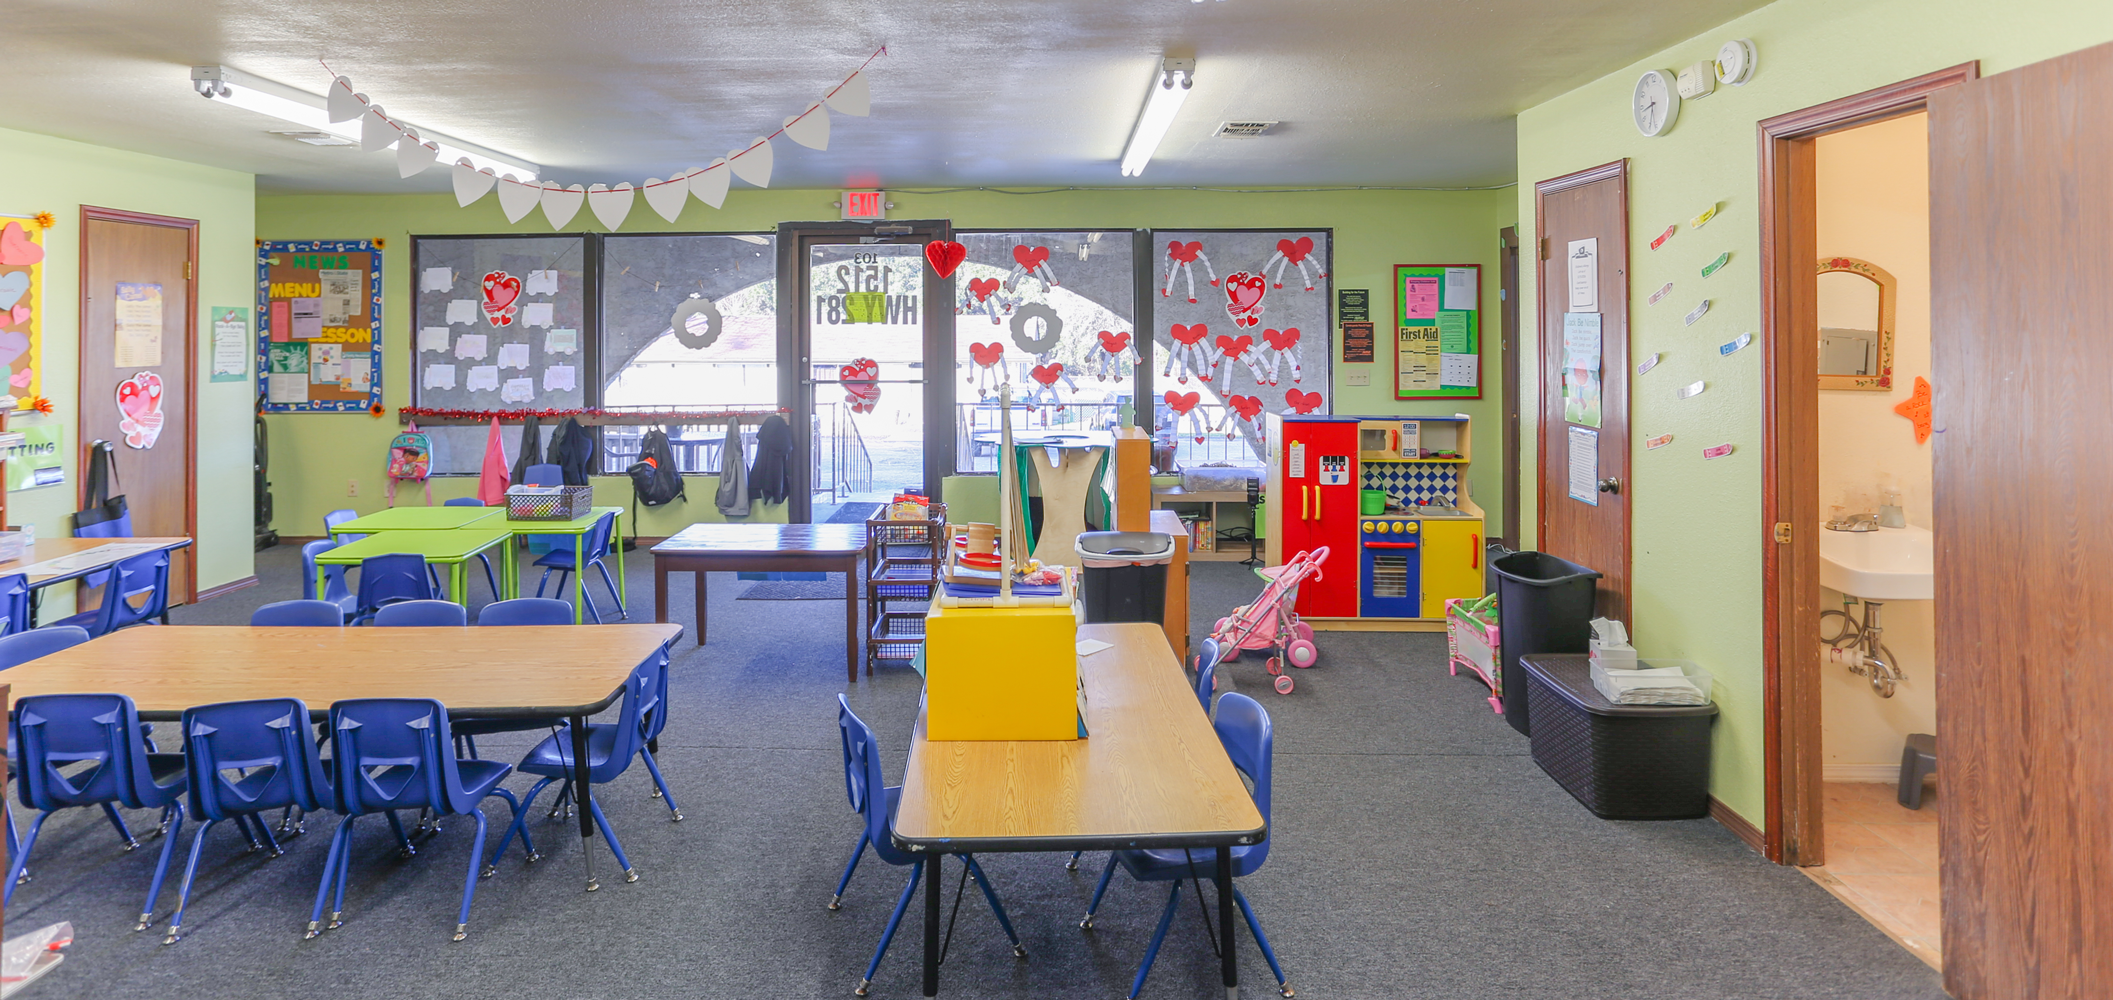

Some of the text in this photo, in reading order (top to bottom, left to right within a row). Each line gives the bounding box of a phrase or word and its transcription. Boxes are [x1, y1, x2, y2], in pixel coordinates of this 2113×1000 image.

[848, 192, 880, 217] EXIT
[293, 255, 350, 270] NEWS
[269, 282, 321, 298] MENU
[308, 327, 372, 343] ESSON
[1401, 328, 1438, 340] First Aid
[8, 442, 55, 457] TTING
